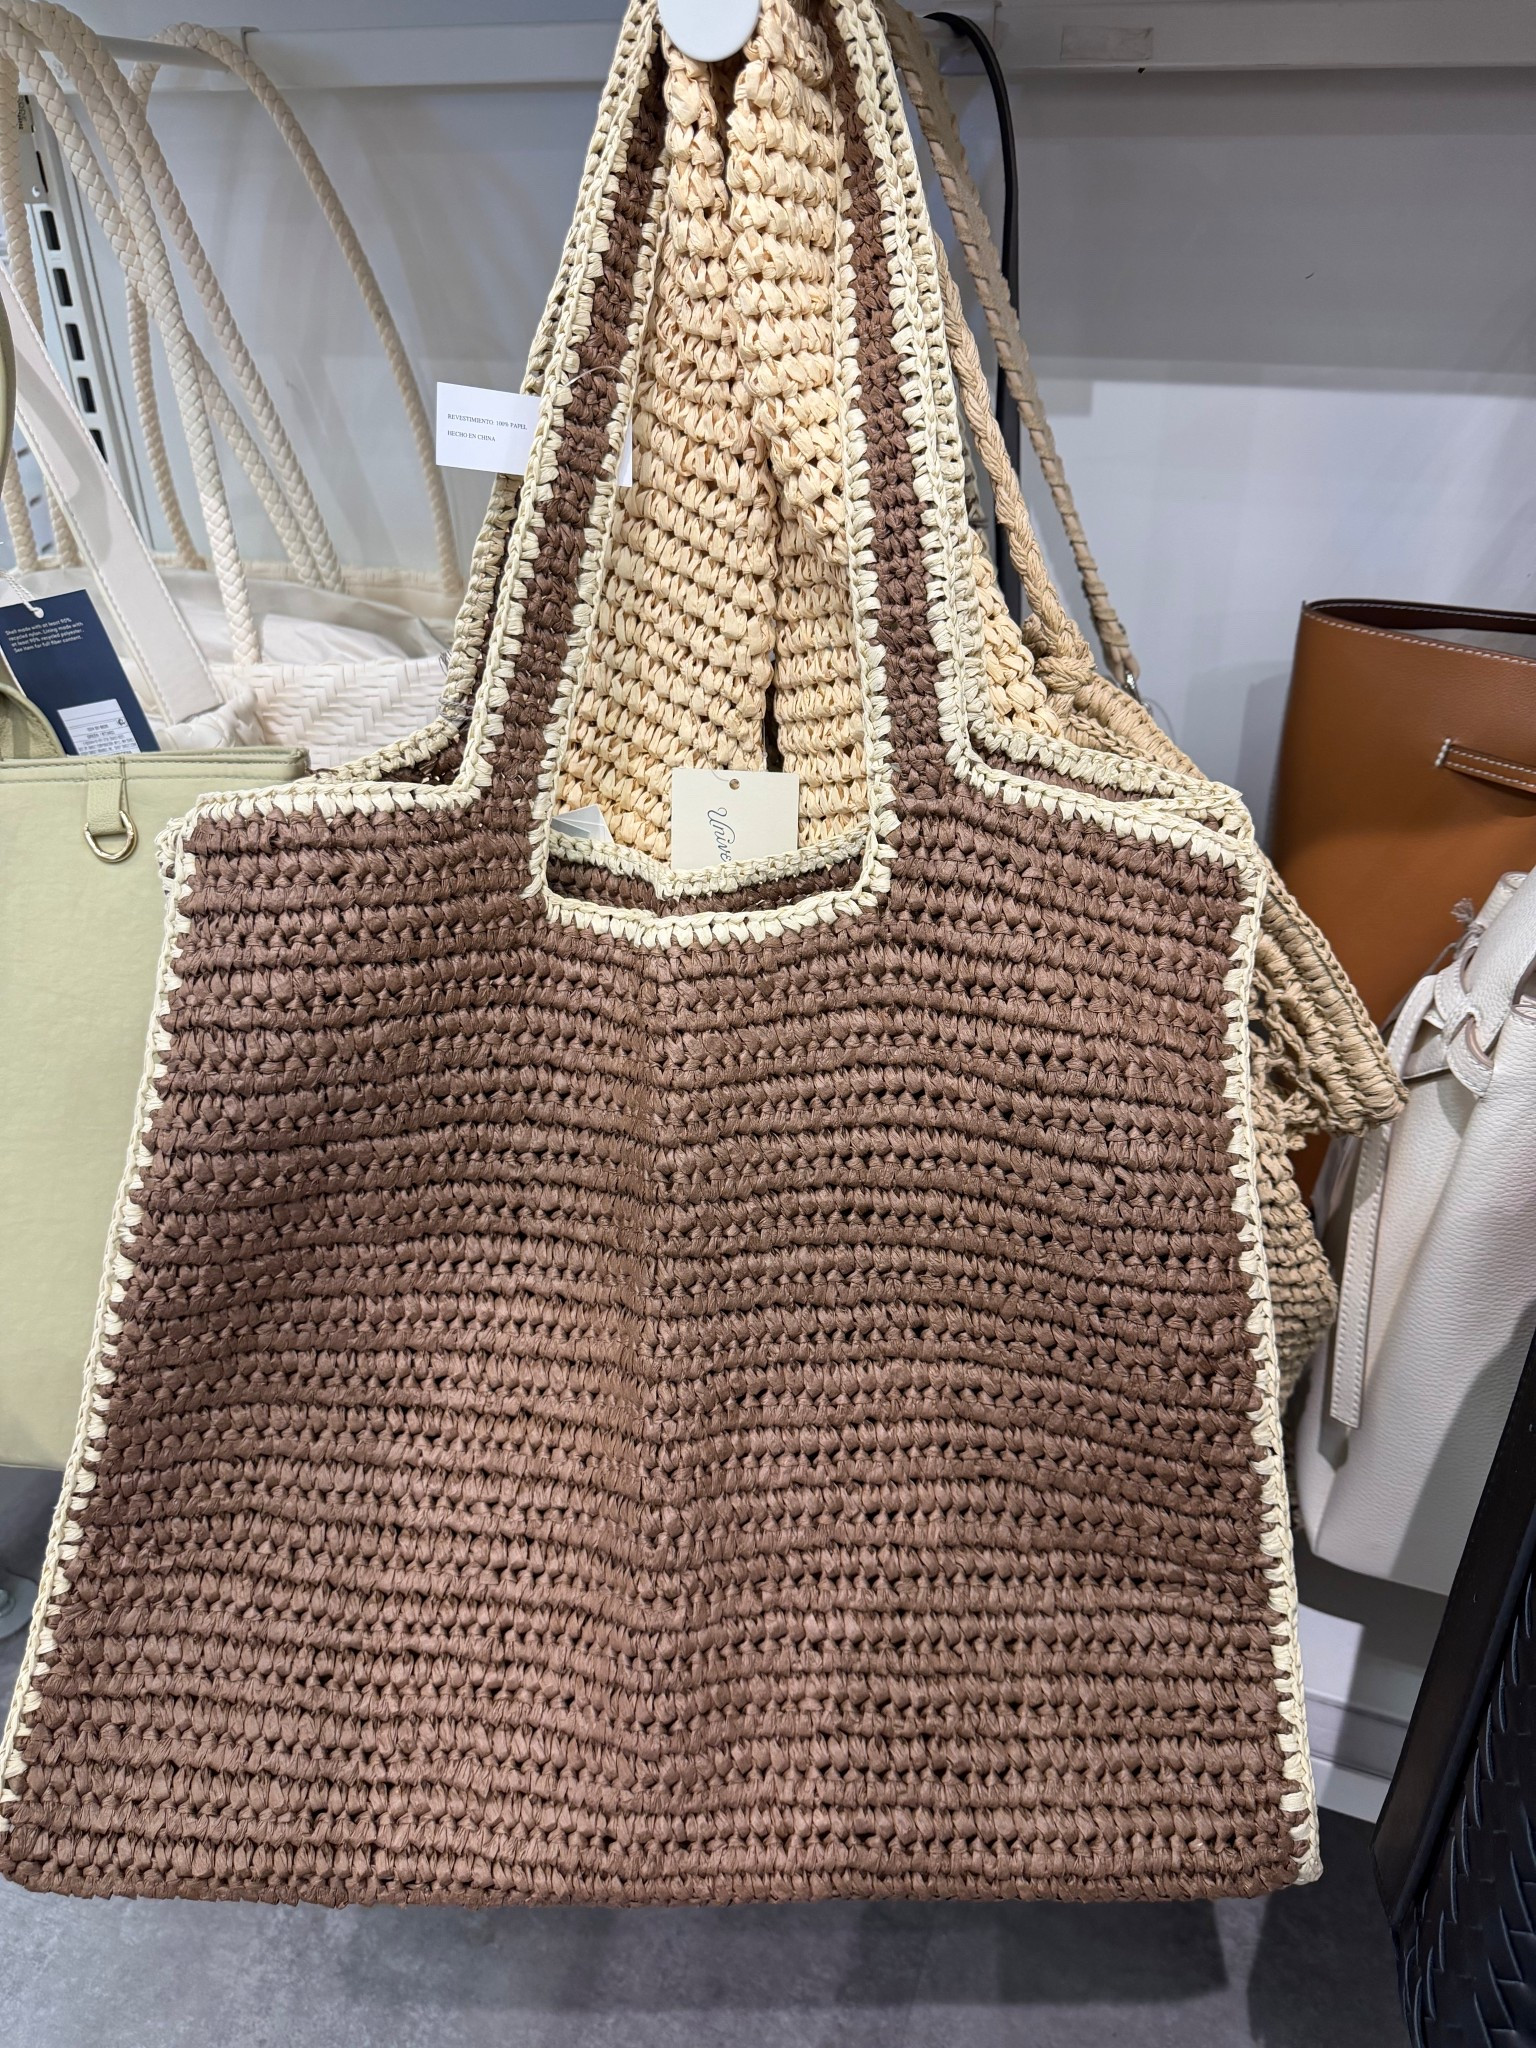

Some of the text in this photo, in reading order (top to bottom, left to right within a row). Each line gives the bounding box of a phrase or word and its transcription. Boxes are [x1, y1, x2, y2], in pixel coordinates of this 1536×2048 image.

[447, 430, 468, 438] HECHO
[477, 434, 496, 442] CHINA
[41, 633, 61, 641] recycled
